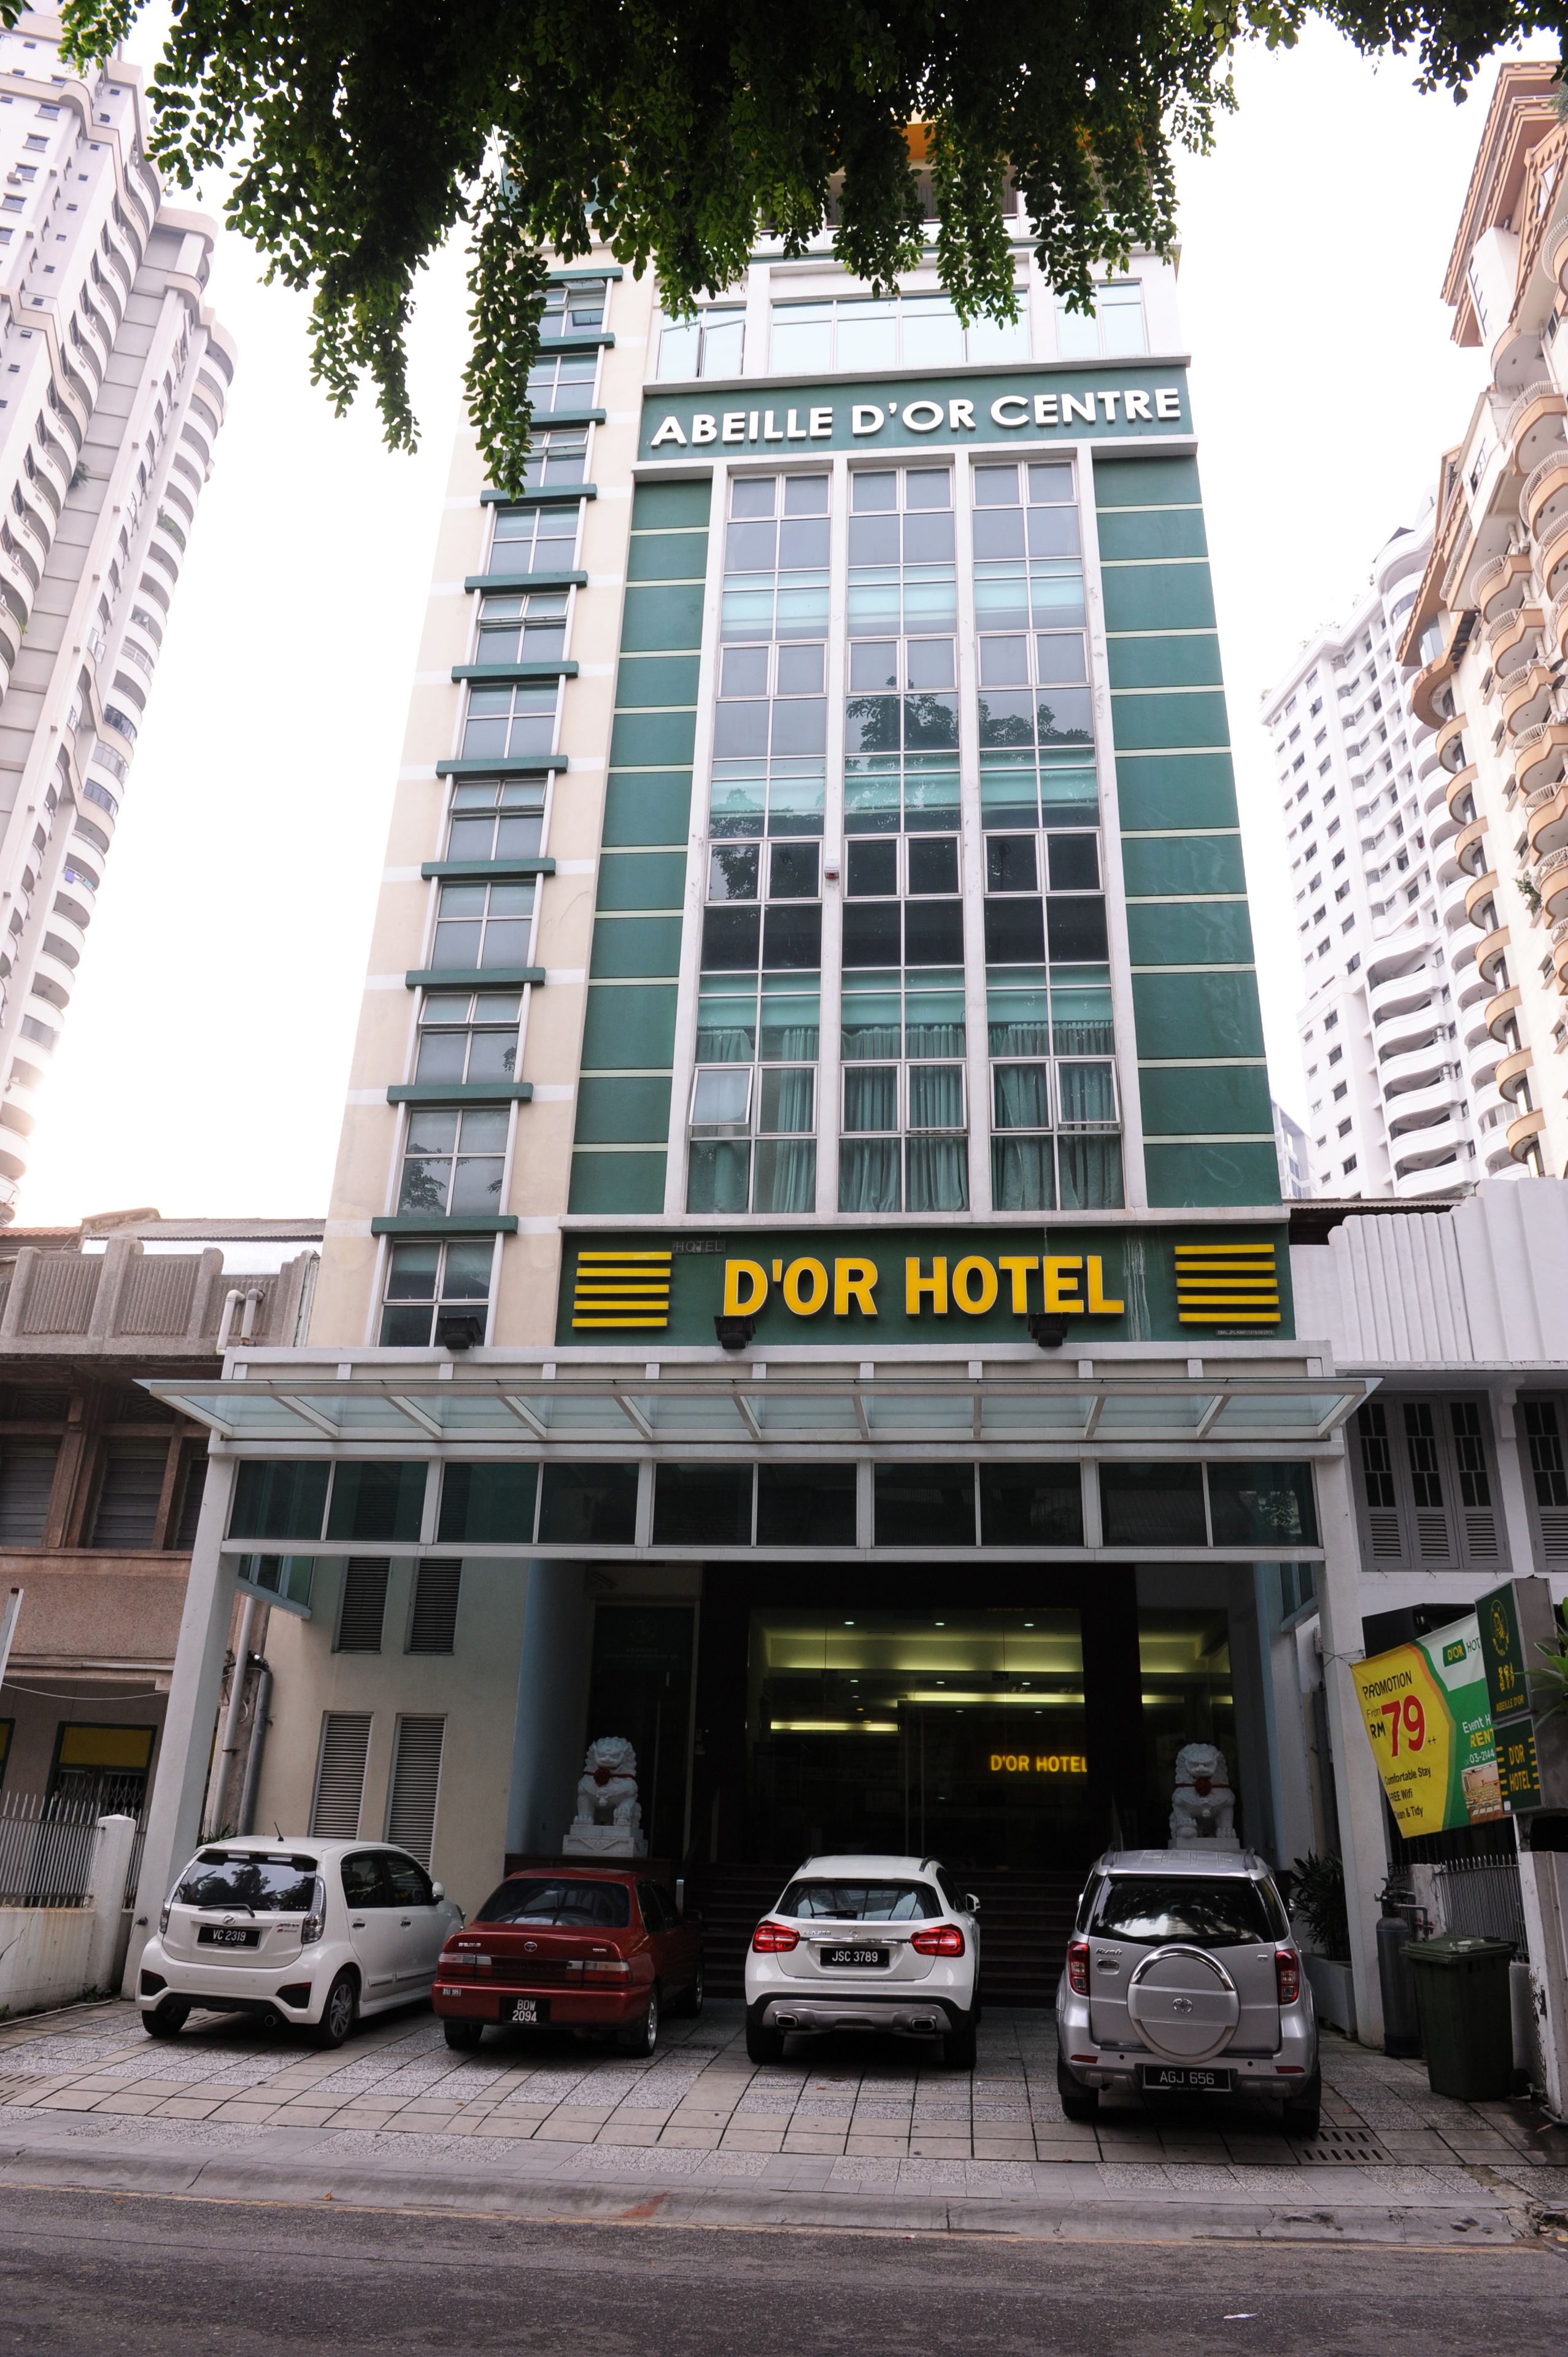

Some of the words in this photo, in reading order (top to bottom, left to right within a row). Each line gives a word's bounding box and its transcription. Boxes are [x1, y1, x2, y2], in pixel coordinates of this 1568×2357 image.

[651, 407, 833, 447] ABEILLE
[852, 399, 976, 436] D'OR
[991, 388, 1181, 428] CENTRE
[675, 1240, 722, 1252] HOTEL
[723, 1257, 878, 1317] D'OR
[905, 1255, 1125, 1317] HOTEL
[1448, 1644, 1464, 1662] D'OR
[1362, 1670, 1412, 1700] PROMOTION
[1496, 1698, 1514, 1713] ABEILLE
[1367, 1708, 1381, 1719] From
[1370, 1721, 1386, 1740] RM
[1381, 1695, 1426, 1758] 79
[1462, 1716, 1485, 1734] Event
[1508, 1744, 1525, 1765] D'OR
[991, 1755, 1030, 1771] D'OR
[1036, 1756, 1088, 1773] HOTEL
[1418, 1767, 1431, 1778] Stay
[1509, 1770, 1531, 1792] HOTEL
[1400, 1788, 1413, 1800] Wifi
[1405, 1808, 1411, 1817] &
[1411, 1806, 1424, 1817] Tidy
[213, 1929, 224, 1940] VC
[225, 1930, 247, 1941] 2319
[832, 1950, 851, 1962] JSC
[853, 1951, 878, 1962] 3789
[517, 1999, 536, 2011] BDW
[512, 2009, 538, 2022] 2094
[1159, 2070, 1184, 2084] AGJ
[1189, 2072, 1215, 2085] 656
